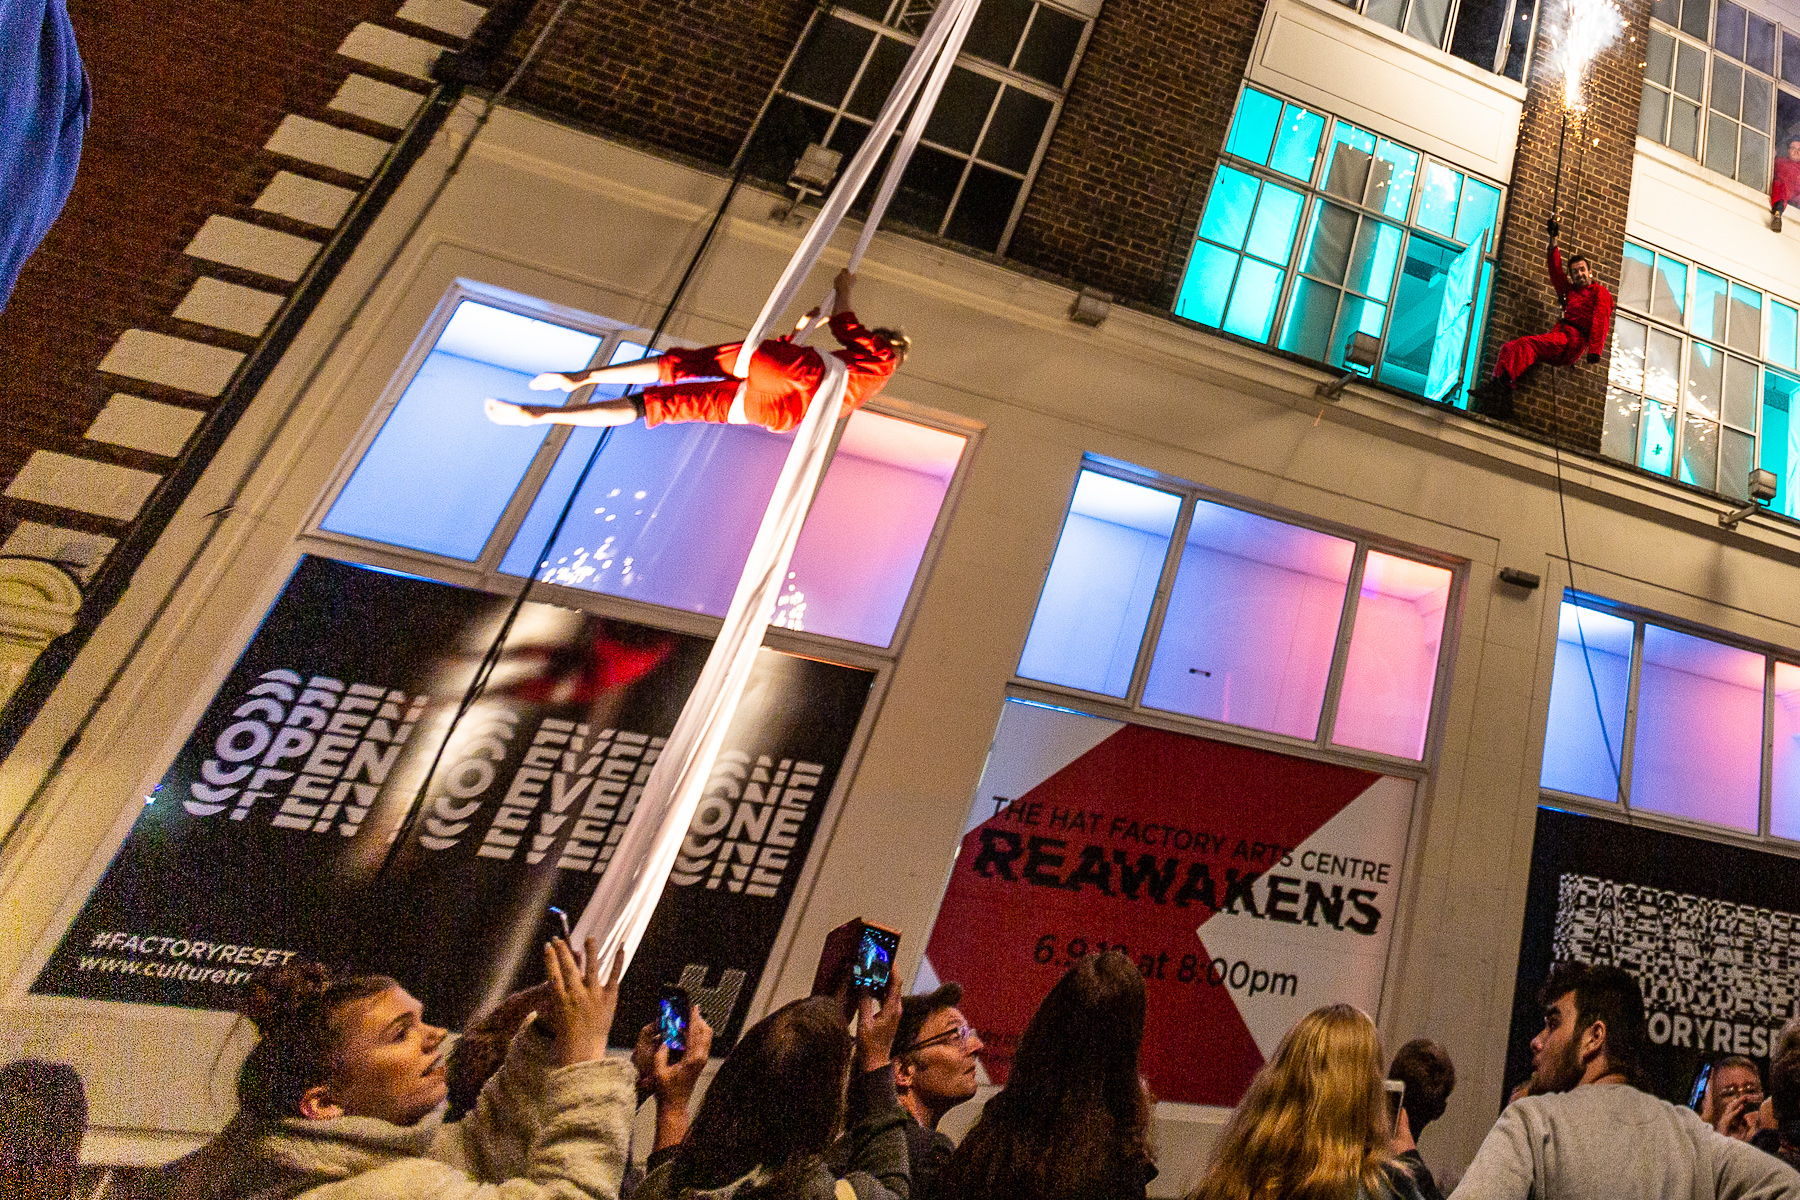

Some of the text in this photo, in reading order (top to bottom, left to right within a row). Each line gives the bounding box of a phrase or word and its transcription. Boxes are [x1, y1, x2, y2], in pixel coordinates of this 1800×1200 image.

[991, 796, 1391, 884] THE HAT FACTORY ARTS CENTRE
[972, 828, 1382, 935] REAWAKENS
[91, 931, 297, 967] #FACTORYRESET
[1177, 953, 1298, 997] 8:00pm
